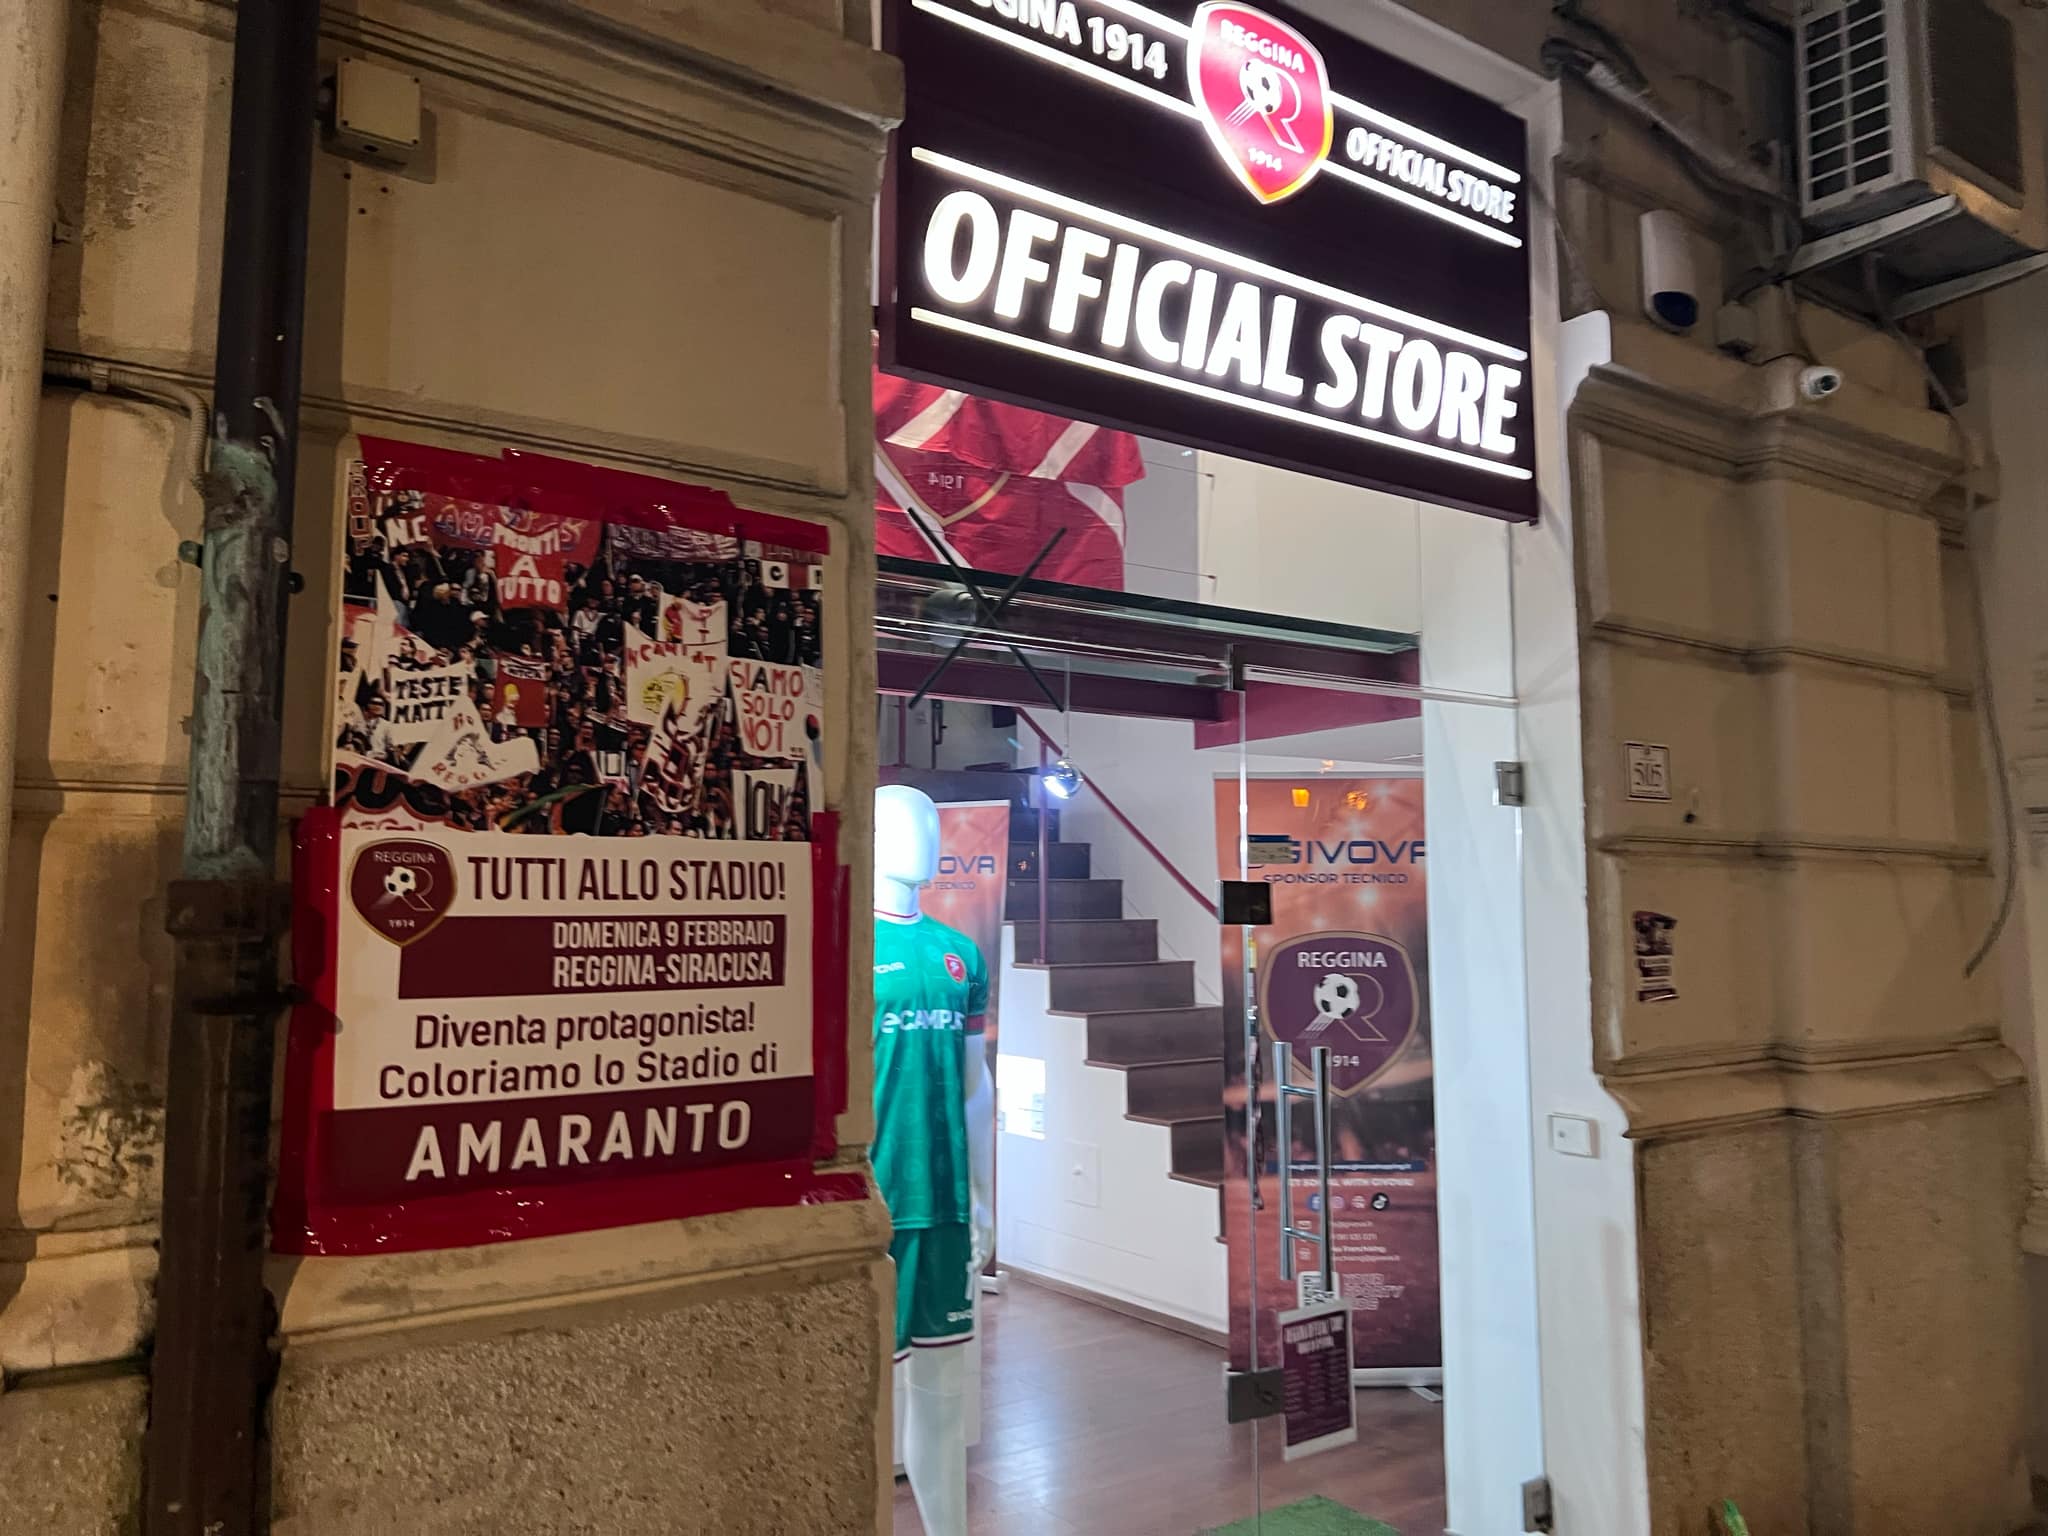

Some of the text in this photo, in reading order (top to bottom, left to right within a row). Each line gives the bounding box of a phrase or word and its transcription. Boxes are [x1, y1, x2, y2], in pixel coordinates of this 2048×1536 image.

[1087, 16, 1168, 79] 1914
[1220, 18, 1306, 74] REGGINA
[1248, 146, 1284, 172] 1914
[1346, 126, 1517, 225] OFFICIAL STORE
[923, 190, 1523, 456] OFFICIAL STORE
[509, 553, 542, 578] A
[498, 575, 562, 604] TUTTO
[395, 675, 464, 701] TESTE
[729, 659, 804, 698] SIAMO
[394, 700, 455, 724] MATT
[742, 692, 795, 722] SOLO
[373, 851, 436, 864] REGGINA
[467, 856, 786, 901] TUTTI ALLO STADIO!
[1263, 873, 1409, 885] SPONSOR TECNICO
[553, 920, 775, 949] DOMENICA 9 FEBBRAIO
[552, 951, 773, 988] REGGINA-SIRACUSA
[1297, 951, 1389, 969] REGGINA
[415, 1002, 755, 1050] Diventa protagonista!
[379, 1042, 778, 1100] Coloriamo lo Stadio di
[404, 1099, 752, 1182] AMARANTO
